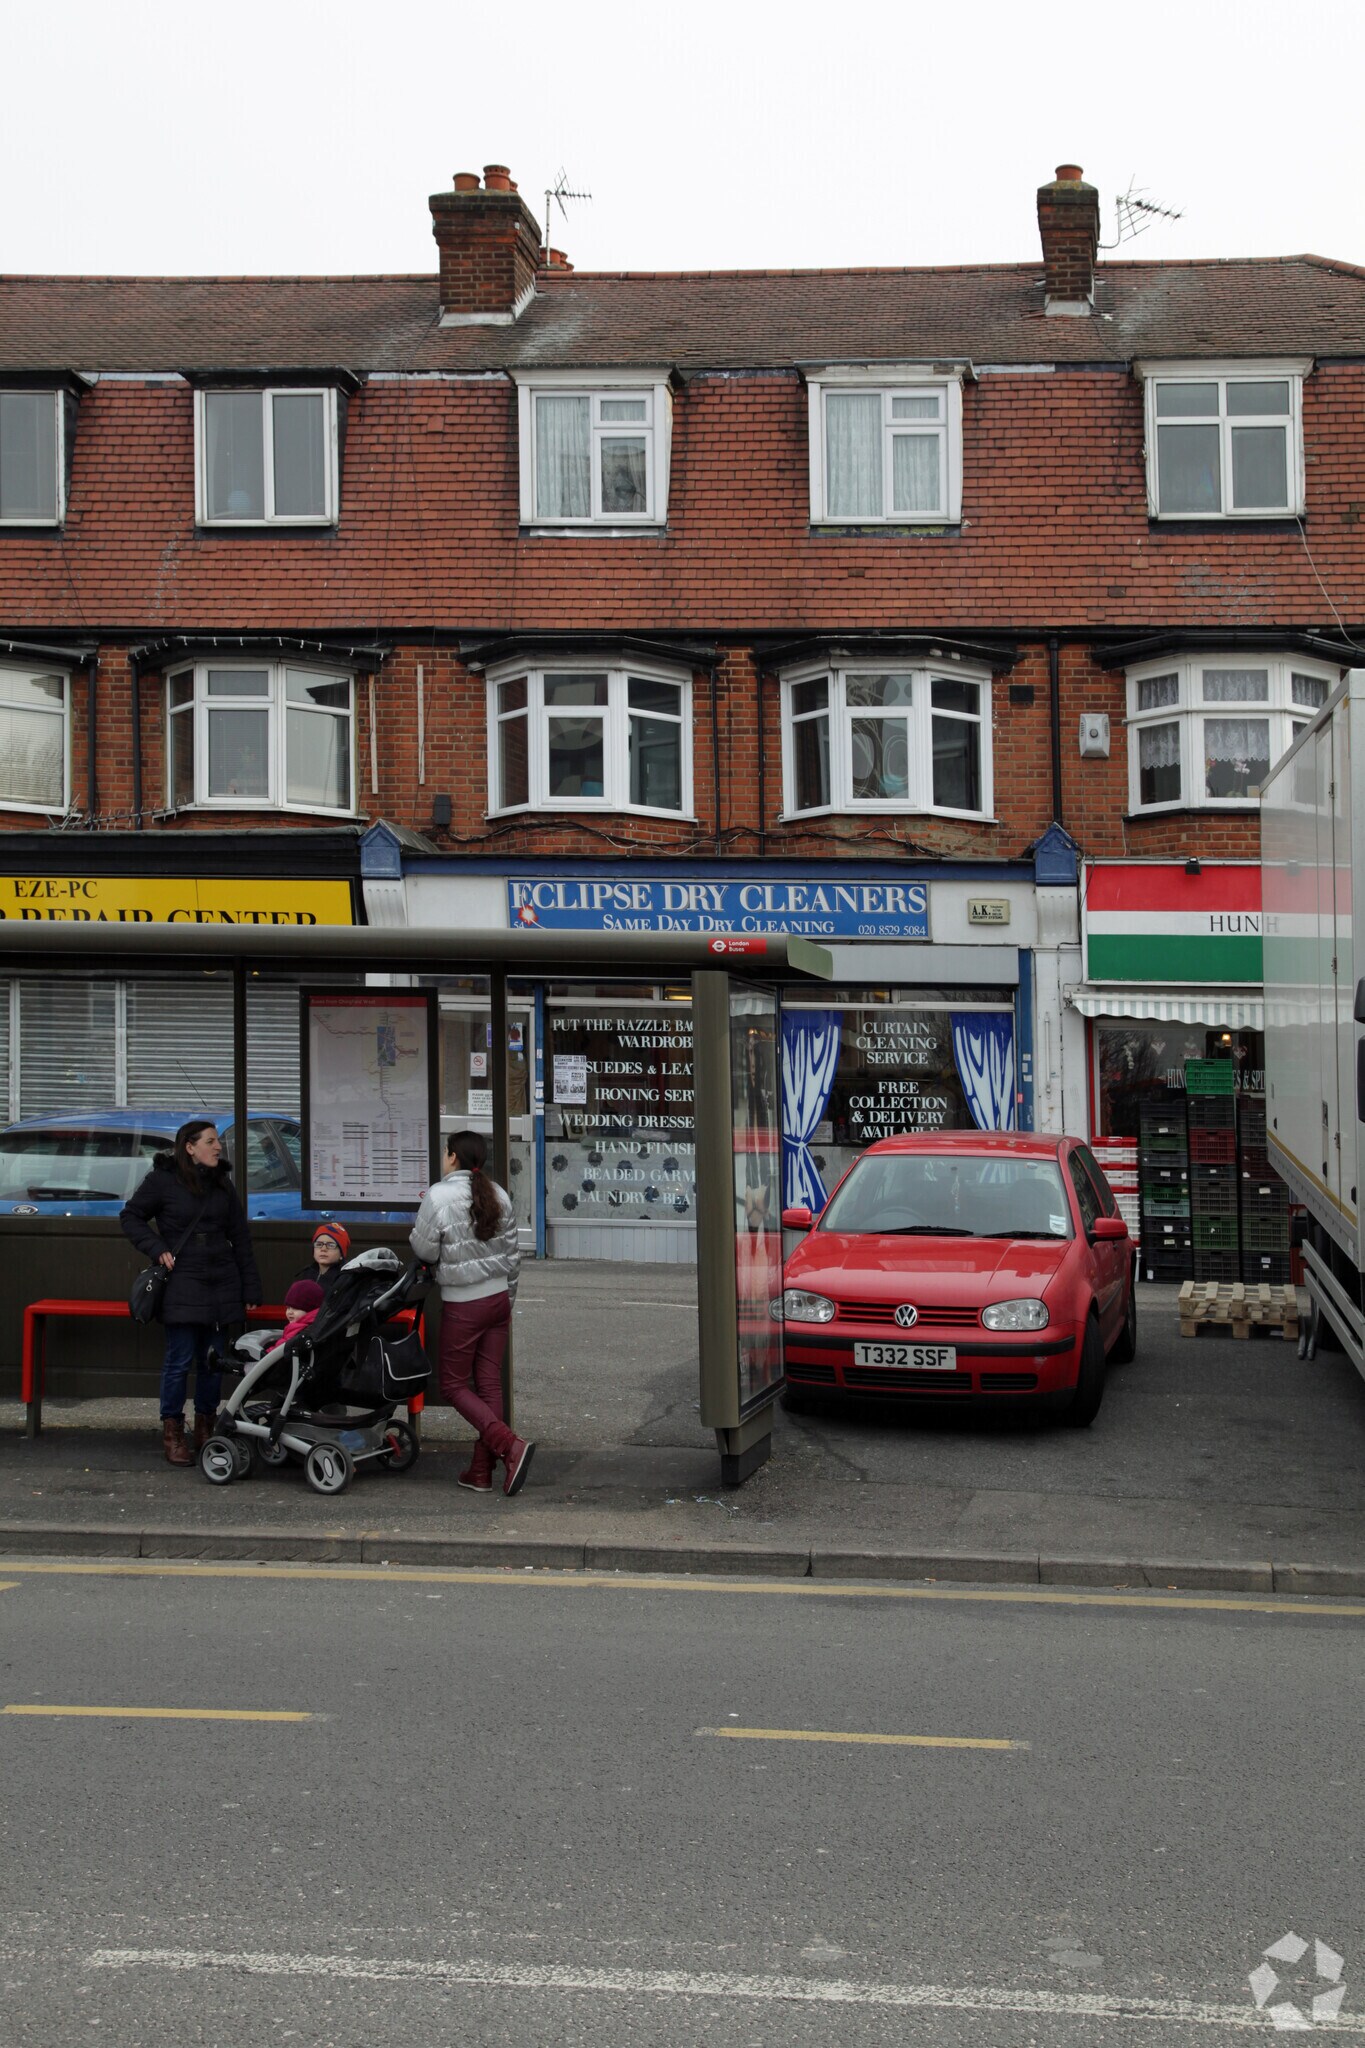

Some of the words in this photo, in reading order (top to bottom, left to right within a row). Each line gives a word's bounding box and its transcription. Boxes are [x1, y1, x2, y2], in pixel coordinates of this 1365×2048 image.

[13, 880, 98, 898] EZE-PC
[509, 882, 653, 910] ECLIPSE
[661, 884, 729, 912] DRY
[739, 885, 927, 914] CLEANERS
[603, 914, 651, 930] SAME
[656, 915, 692, 931] DAY
[697, 916, 735, 932] DRY
[741, 916, 835, 933] CLEANING
[858, 924, 876, 935] 020
[878, 925, 900, 935] 8529
[903, 925, 926, 936] 5084
[553, 1019, 580, 1031] PUT
[582, 1019, 613, 1031] THE
[616, 1019, 671, 1031] RAZZLE
[862, 1022, 930, 1035] CURTAIN
[617, 1035, 694, 1048] WARDROB
[855, 1036, 938, 1050] CLEANING
[866, 1051, 929, 1064] SERVICE
[585, 1061, 643, 1074] SUEDES
[647, 1065, 657, 1075] &
[594, 1087, 660, 1101] IRONING
[878, 1081, 919, 1094] FREE
[849, 1096, 948, 1109] COLLECTION
[557, 1114, 633, 1127] WEDDING
[851, 1110, 865, 1123] &
[869, 1111, 946, 1124] DELIVERY
[595, 1141, 641, 1153] HAND
[583, 1168, 646, 1181] BEADED
[577, 1190, 648, 1204] LAUNDRY
[861, 1345, 908, 1365] T332
[913, 1348, 949, 1366] SSF
